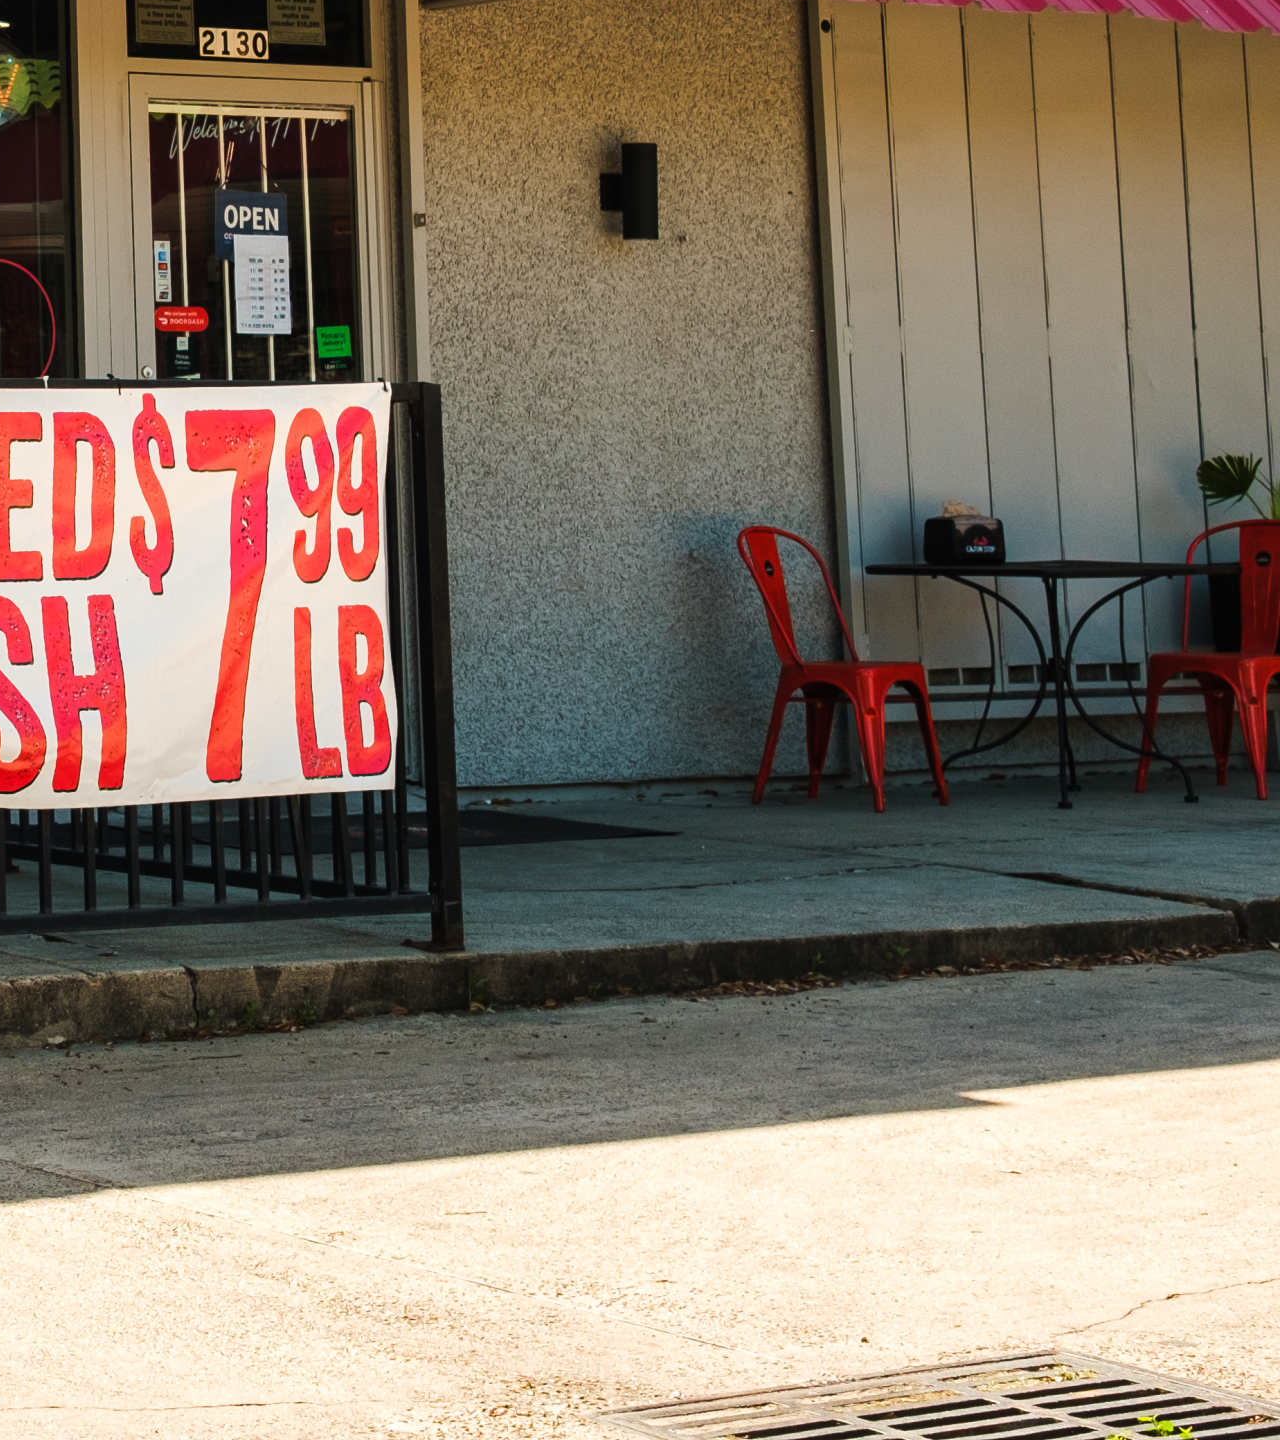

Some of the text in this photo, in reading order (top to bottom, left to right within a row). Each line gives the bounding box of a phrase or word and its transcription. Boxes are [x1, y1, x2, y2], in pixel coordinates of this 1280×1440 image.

[202, 30, 268, 57] 2130
[224, 204, 279, 231] OPEN
[292, 604, 392, 779] LB
